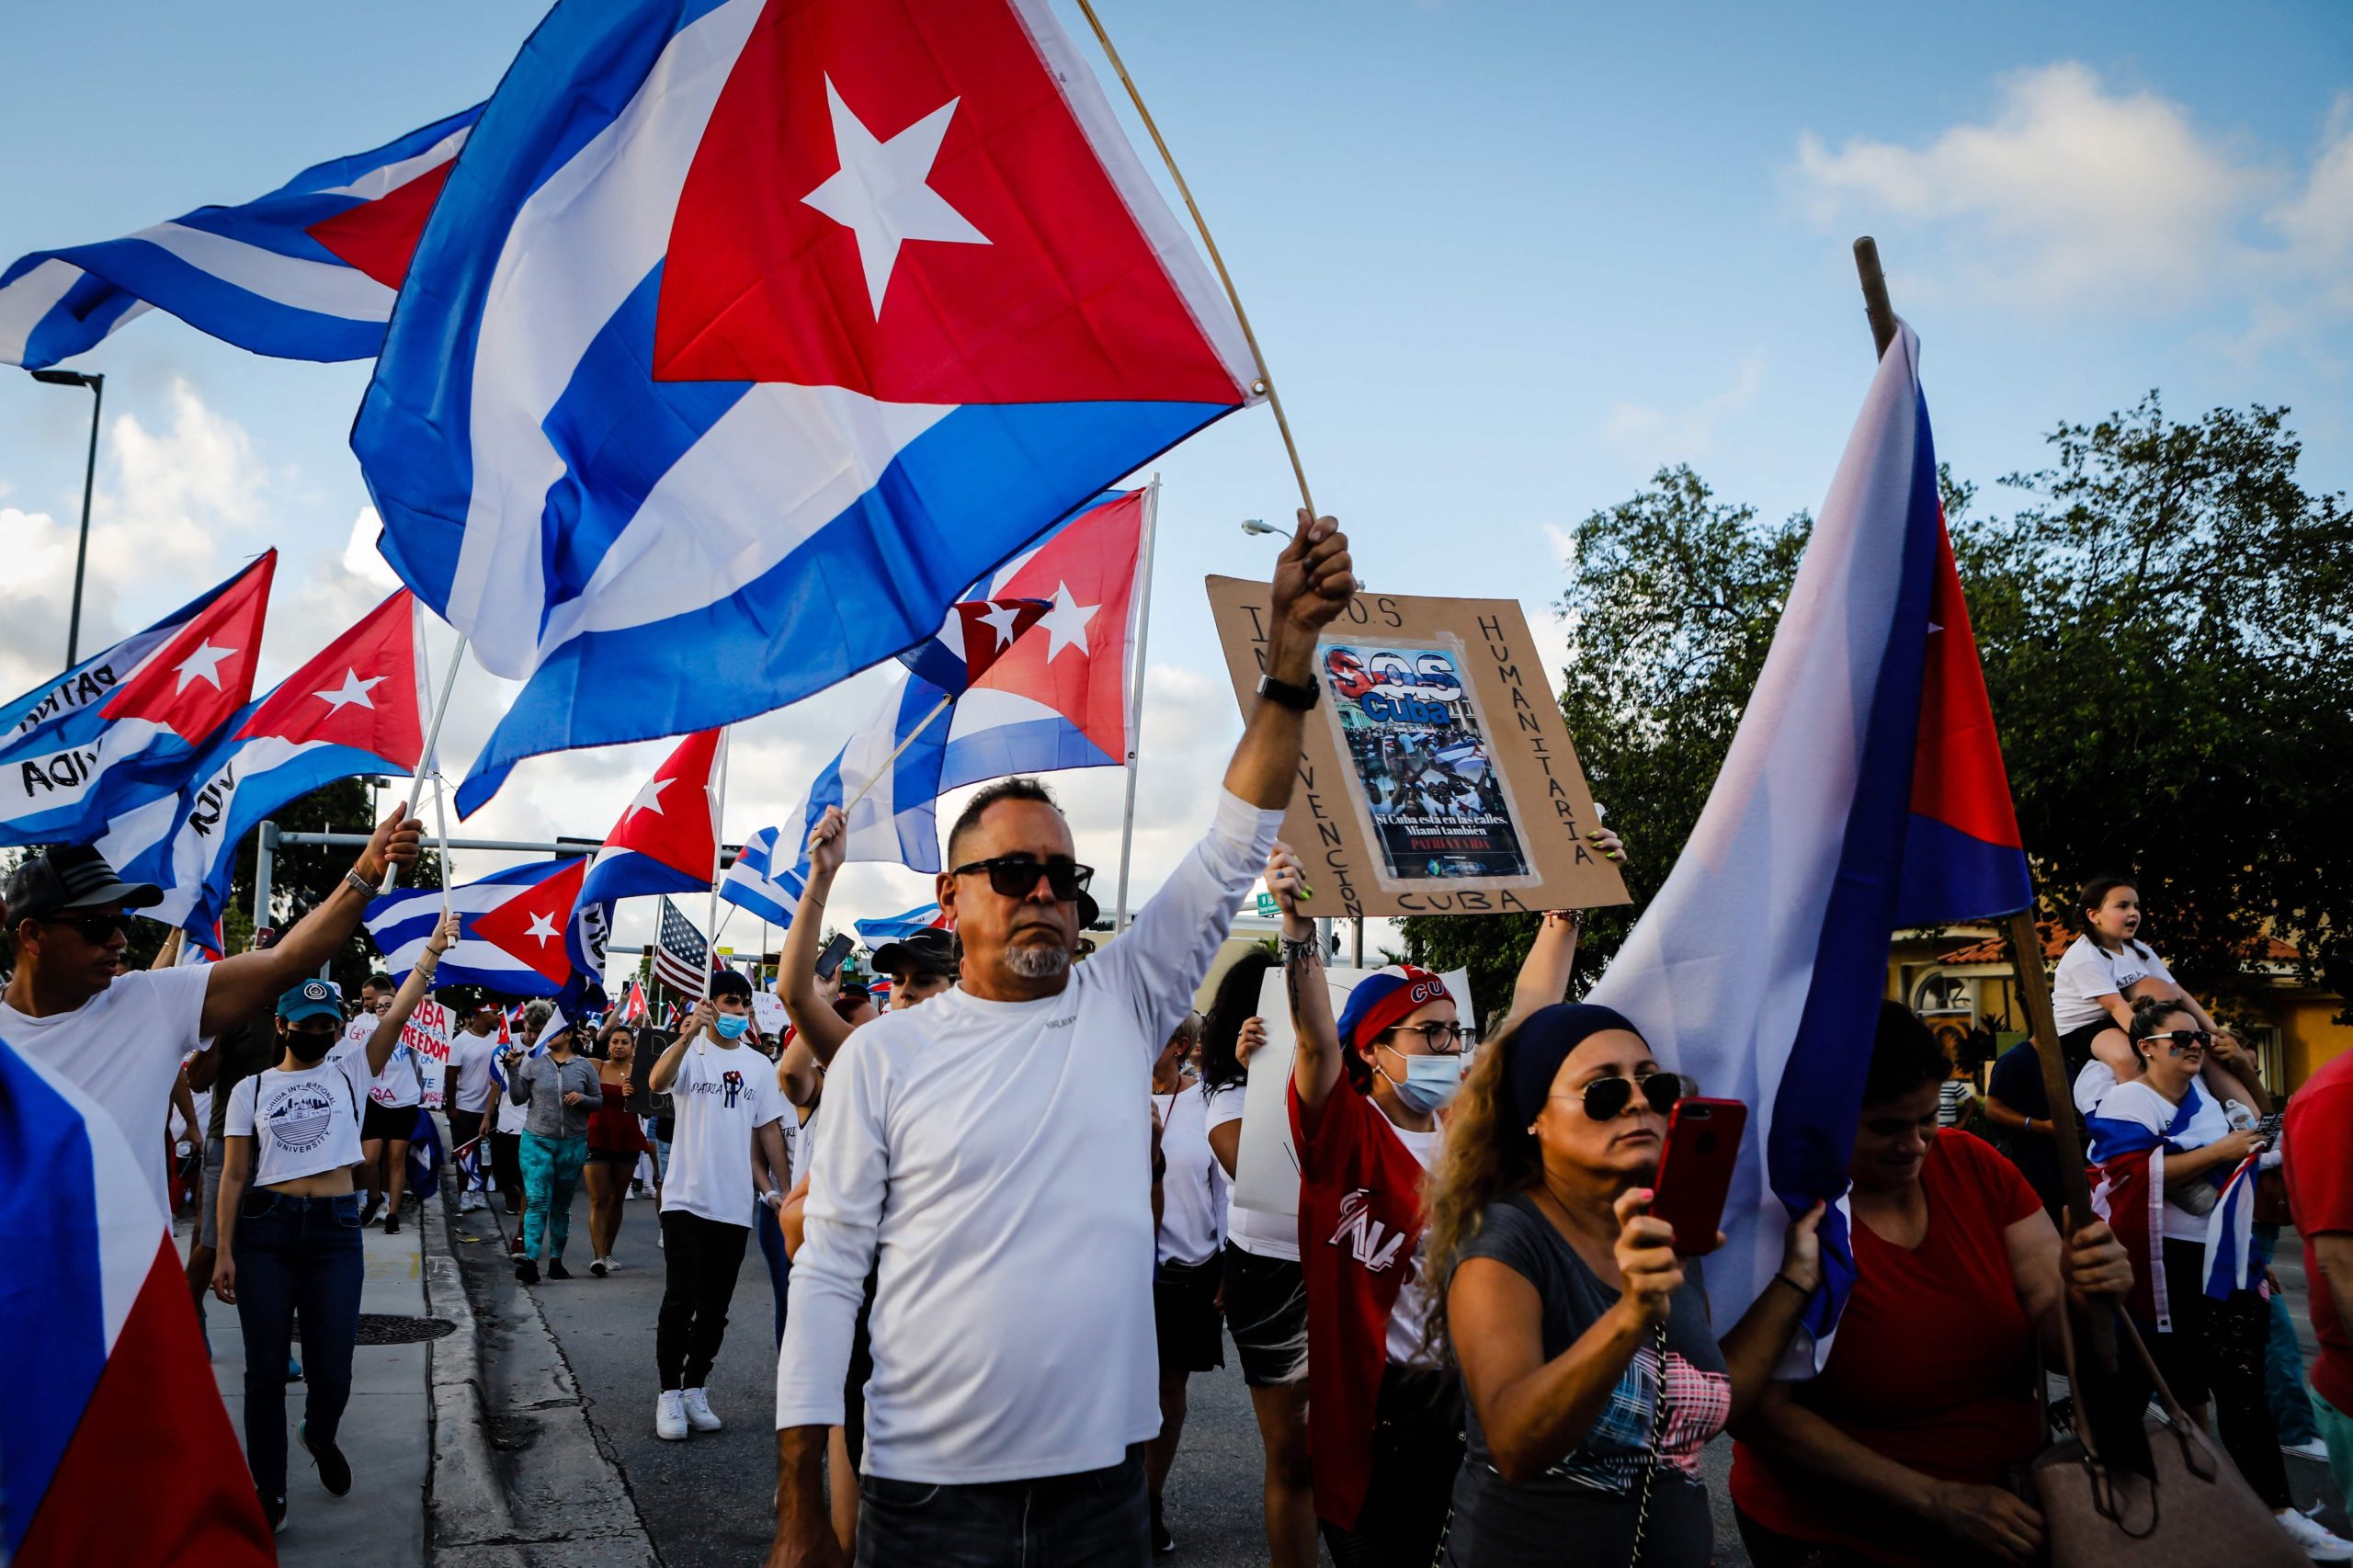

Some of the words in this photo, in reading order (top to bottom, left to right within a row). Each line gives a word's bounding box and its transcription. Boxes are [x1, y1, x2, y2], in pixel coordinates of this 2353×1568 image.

[1325, 648, 1462, 702] SOS
[1360, 691, 1451, 726] Cuba
[1478, 615, 1594, 866] HUMANITARIA
[1375, 814, 1388, 824] Si
[1388, 814, 1418, 824] Cuba
[1442, 816, 1456, 824] en
[1456, 814, 1472, 824] las
[1404, 825, 1440, 835] Miami
[1440, 825, 1487, 835] también
[1398, 890, 1528, 911] CUBA
[2115, 971, 2146, 988] ATRIA
[412, 999, 446, 1034] UBA
[402, 1023, 450, 1063] REEDOM
[264, 1091, 288, 1121] FLORIDA
[277, 1131, 330, 1153] UNIVERSITY
